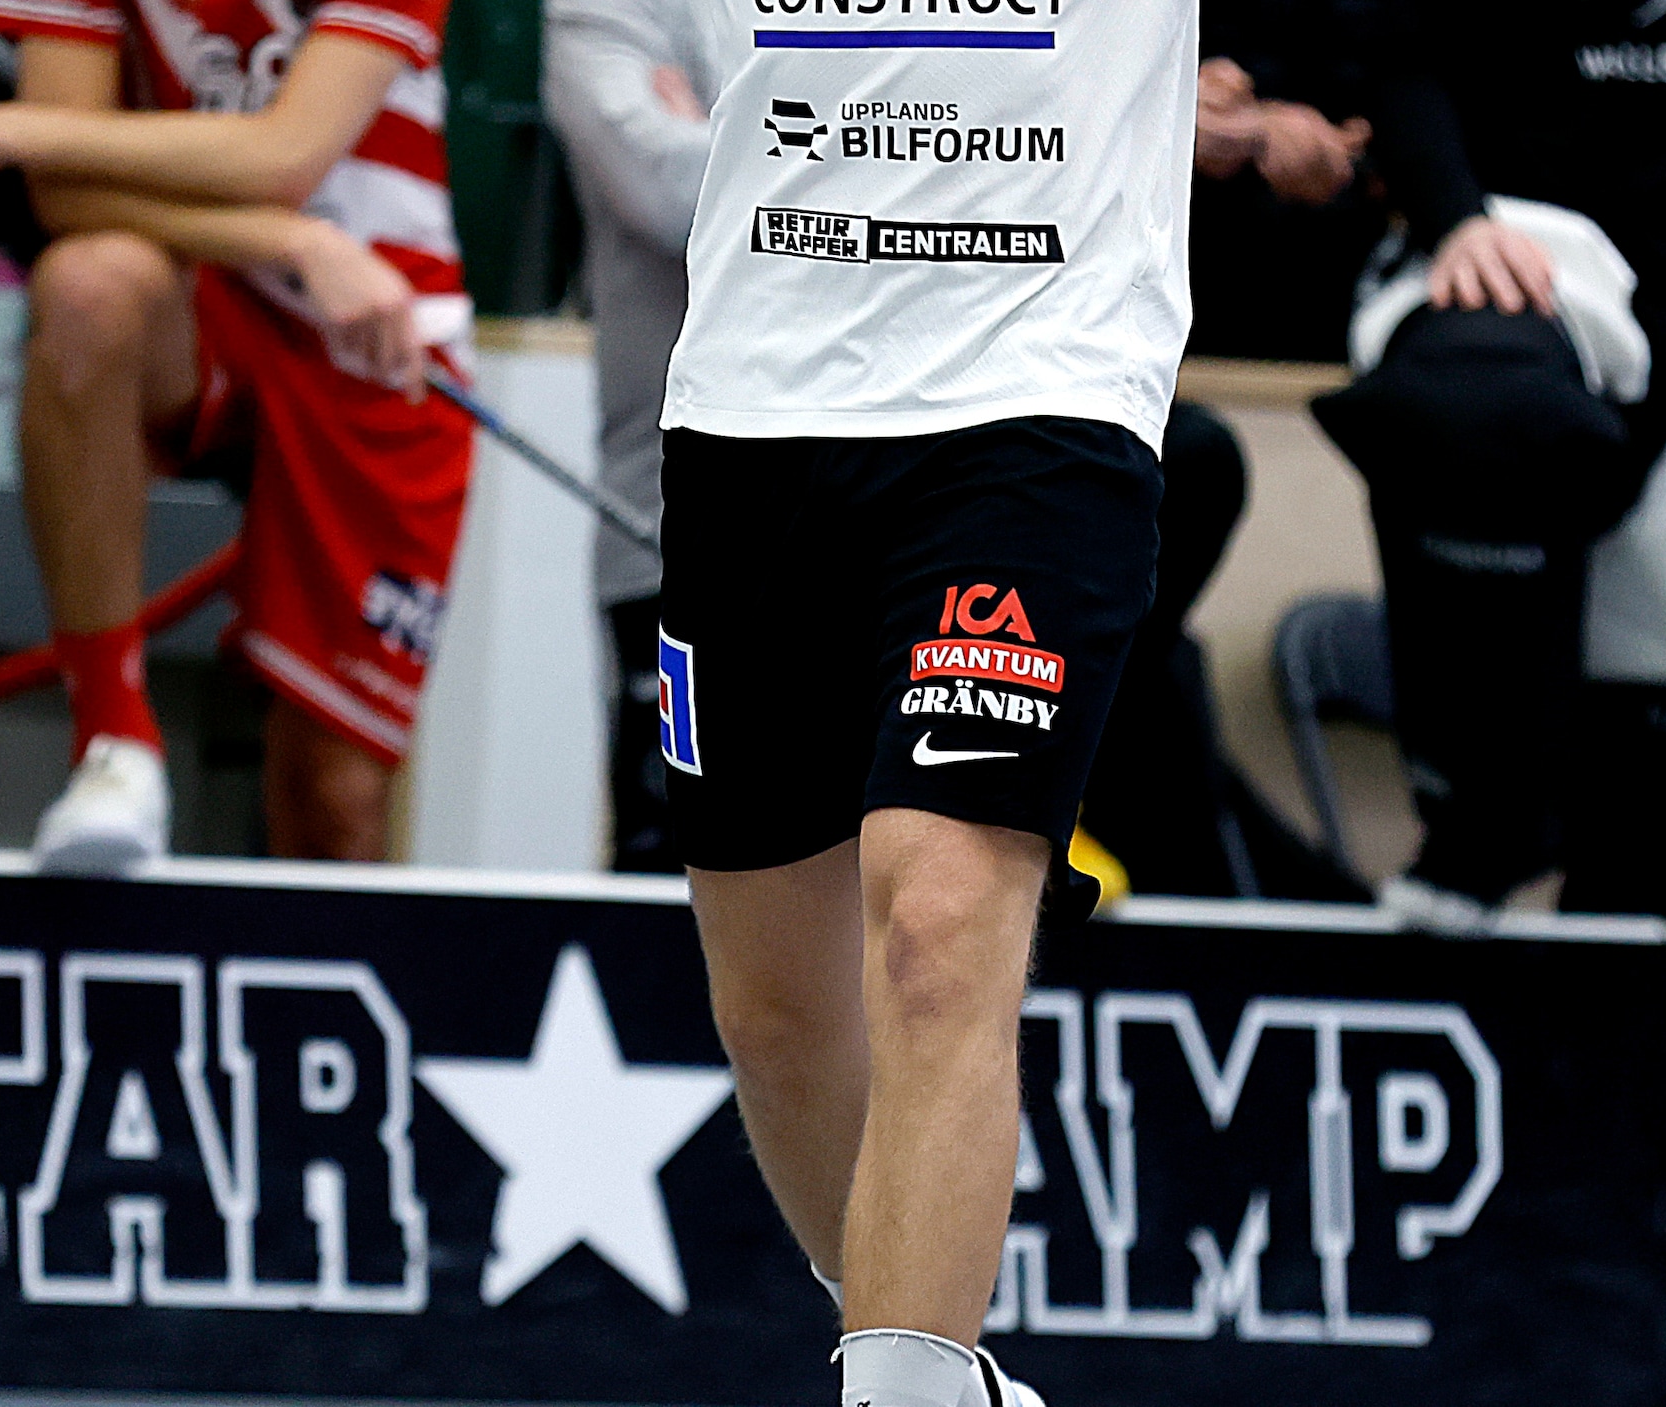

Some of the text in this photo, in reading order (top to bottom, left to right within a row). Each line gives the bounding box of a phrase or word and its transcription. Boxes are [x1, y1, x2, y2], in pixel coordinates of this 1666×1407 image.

[841, 101, 959, 121] UPPLANDS
[841, 125, 1064, 163] BILFORUM
[767, 212, 850, 237] RETUR
[879, 227, 1048, 257] CENTRALEN
[770, 231, 858, 258] PAPPER
[939, 583, 1037, 642] ICA
[915, 646, 1058, 683] KVANTUM
[900, 679, 1060, 731] GRÄNBY
[981, 990, 1504, 1347] AMP
